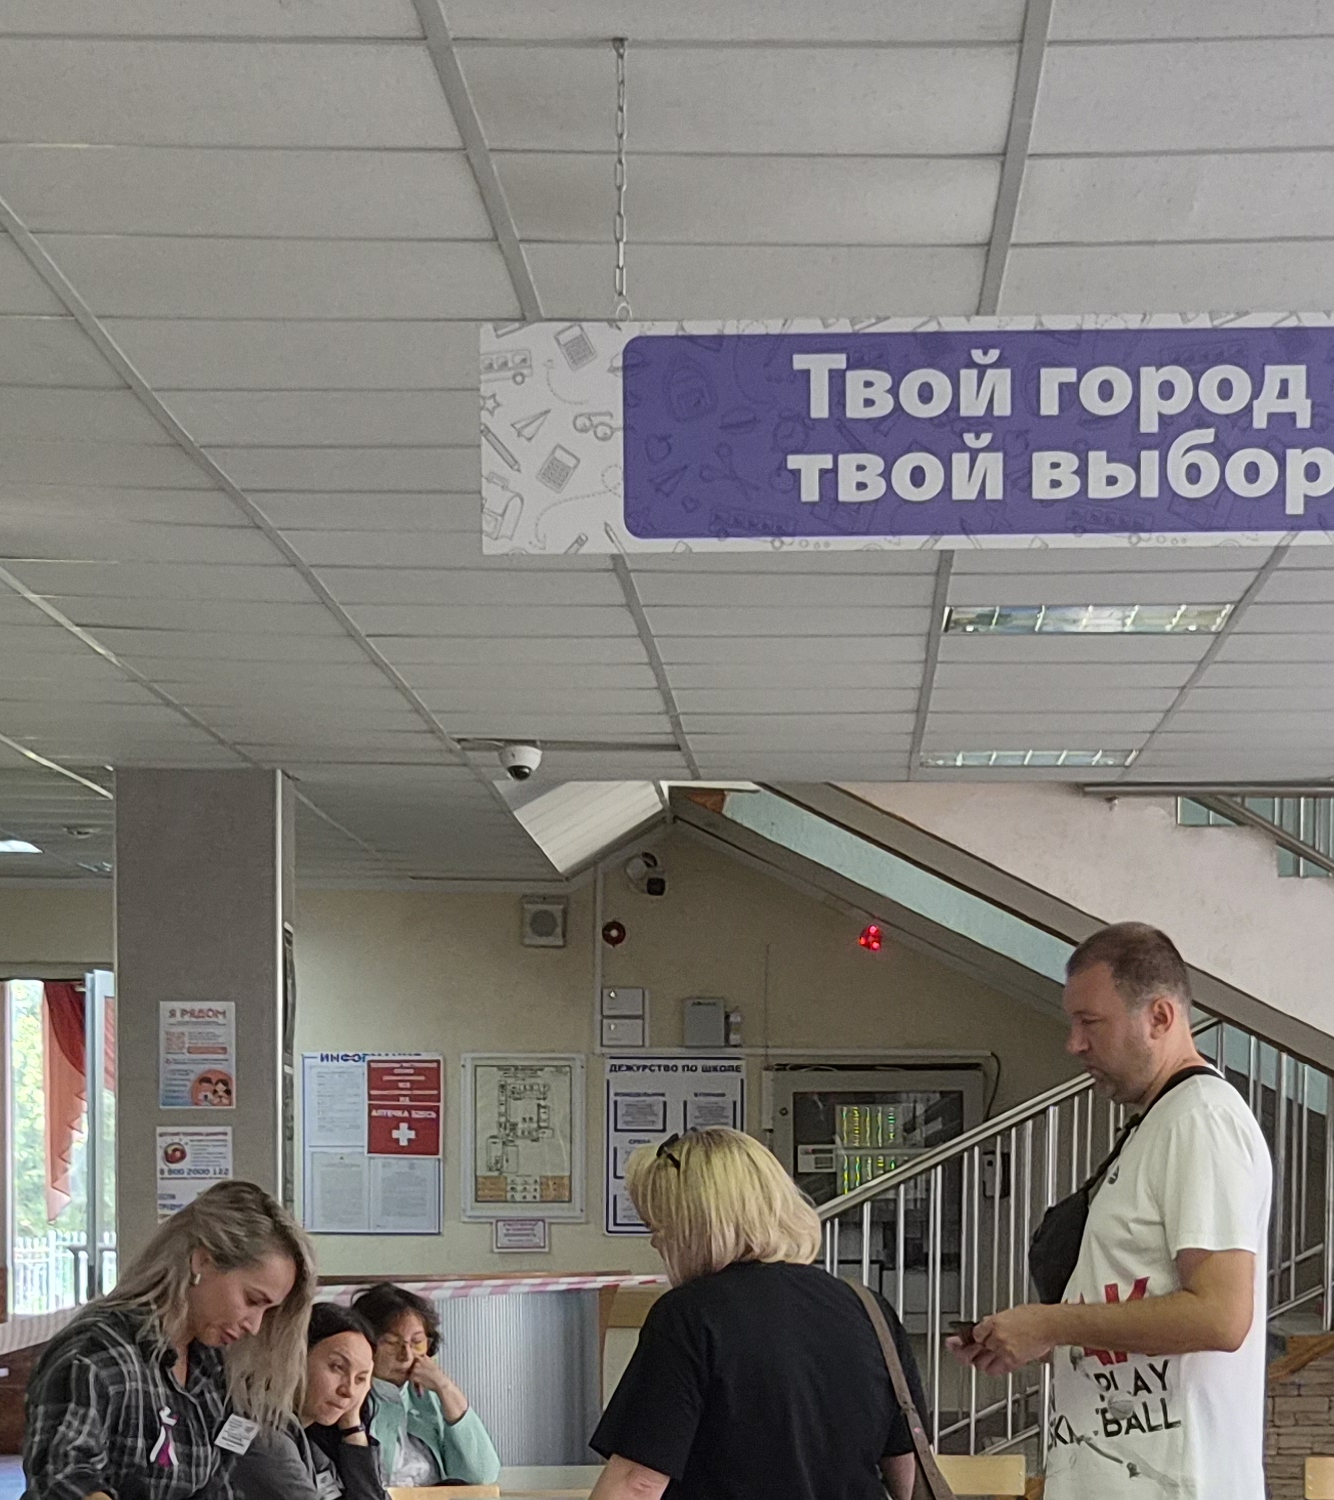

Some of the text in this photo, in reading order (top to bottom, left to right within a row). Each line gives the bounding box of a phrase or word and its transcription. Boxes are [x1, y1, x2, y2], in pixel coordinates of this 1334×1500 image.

[792, 349, 1012, 419] Твой
[1040, 364, 1313, 433] город
[787, 432, 1004, 503] твой
[608, 1063, 743, 1073] ДЕЖУРСТВО ПО ШКОЛЕ
